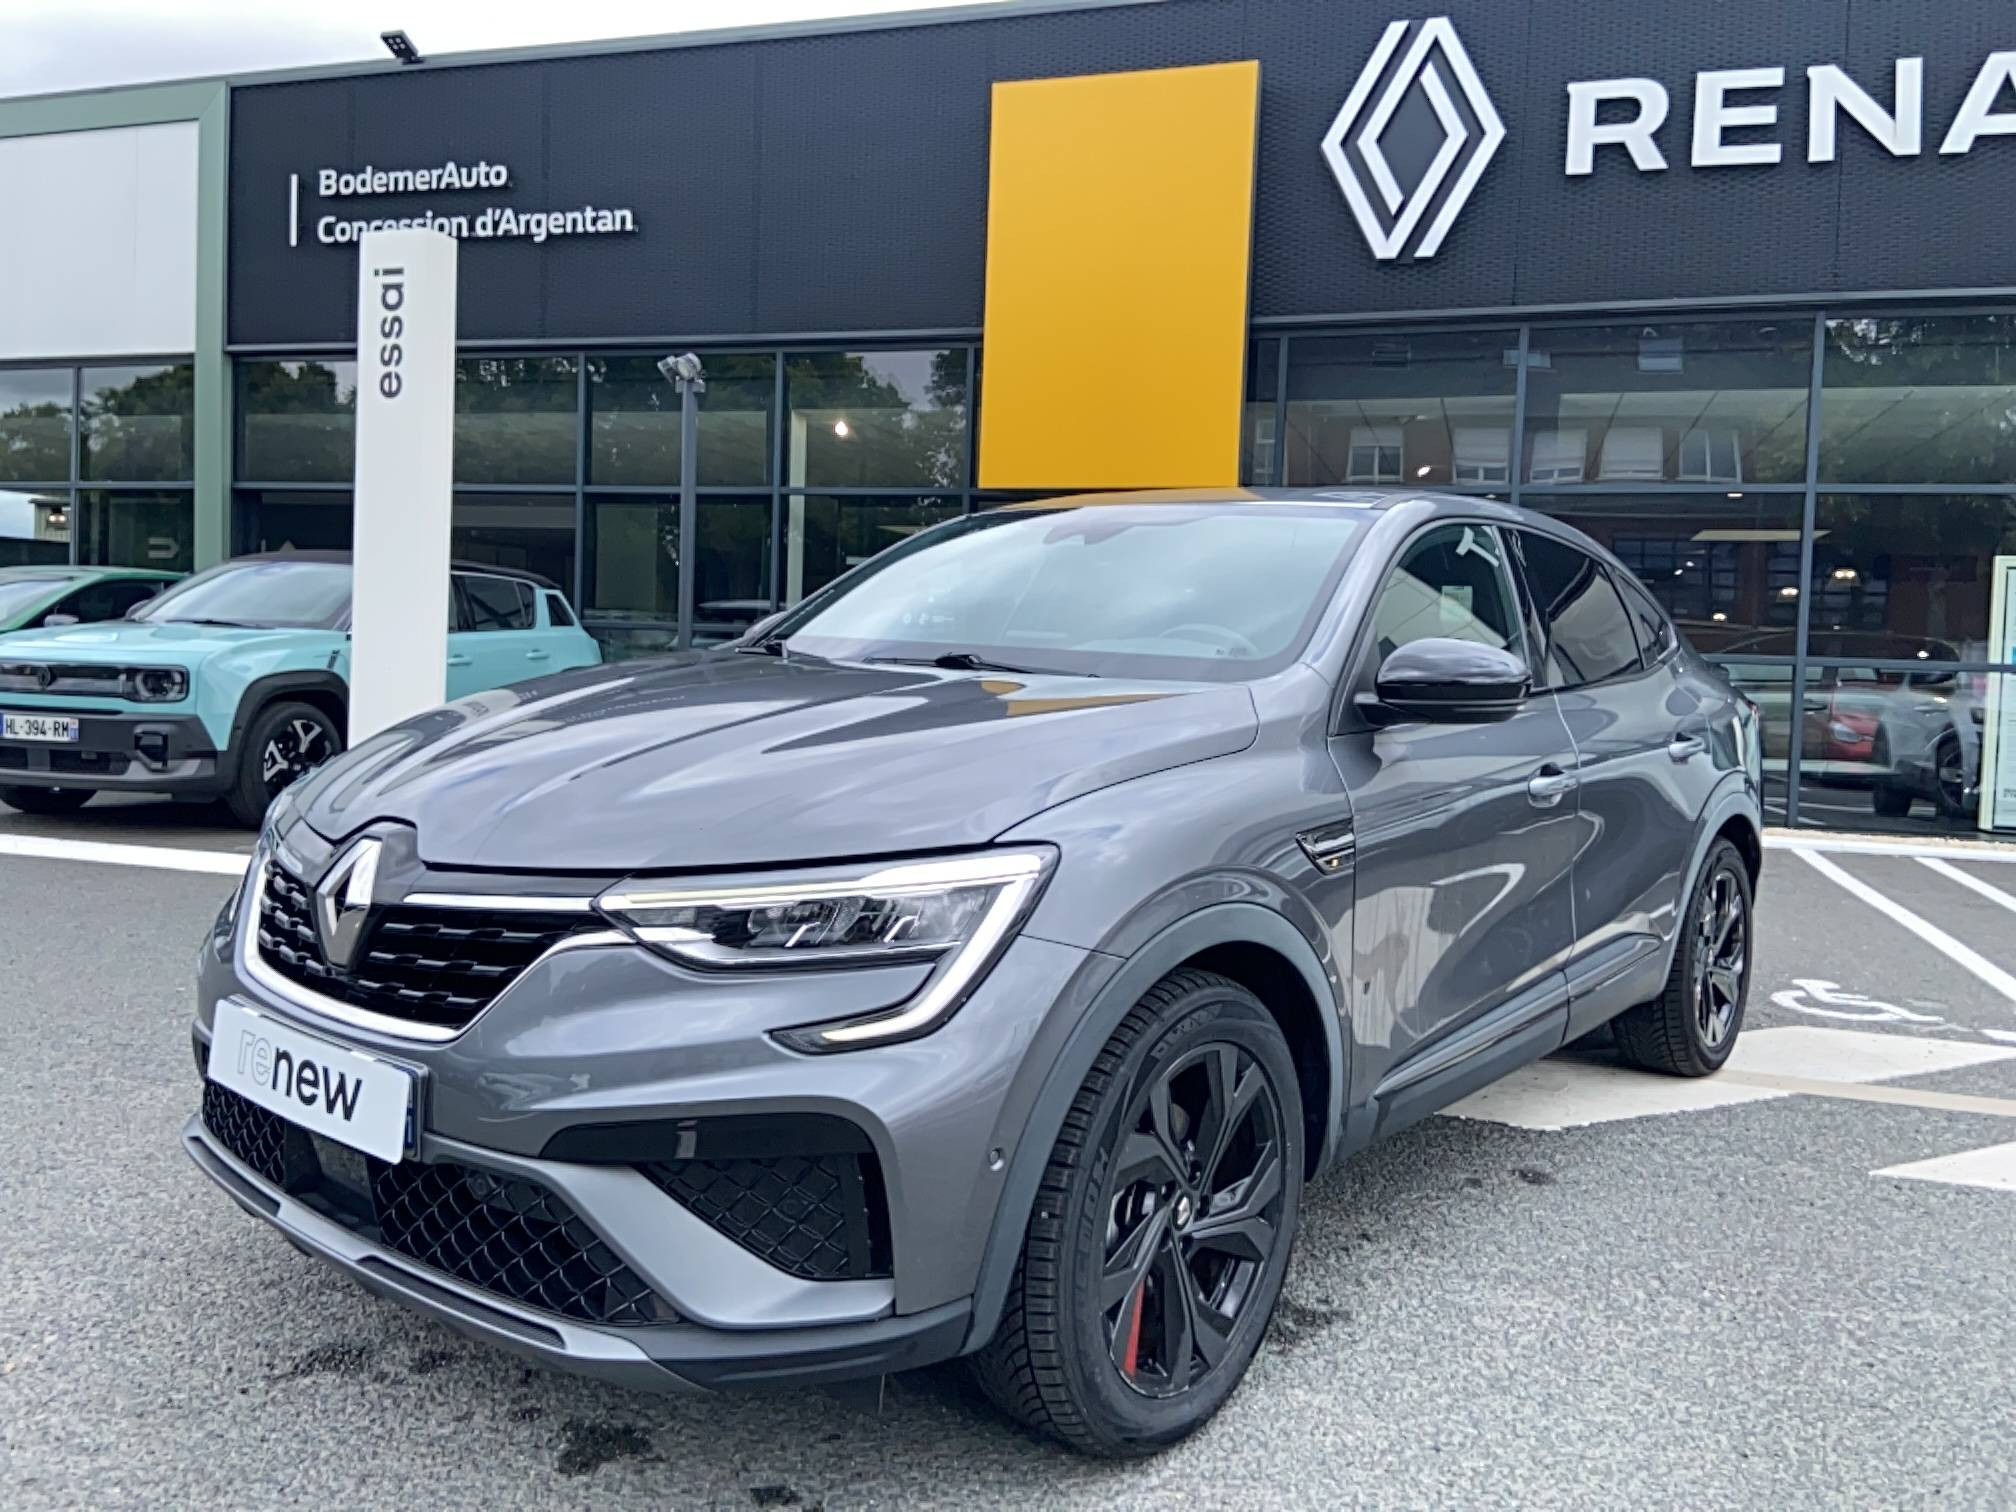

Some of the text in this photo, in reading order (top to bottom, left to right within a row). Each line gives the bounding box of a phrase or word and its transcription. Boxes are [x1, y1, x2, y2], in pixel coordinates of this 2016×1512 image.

[318, 161, 508, 196] BodemerAuto
[475, 206, 634, 242] d'Argentan
[374, 267, 405, 399] essai
[236, 1029, 362, 1122] renew
